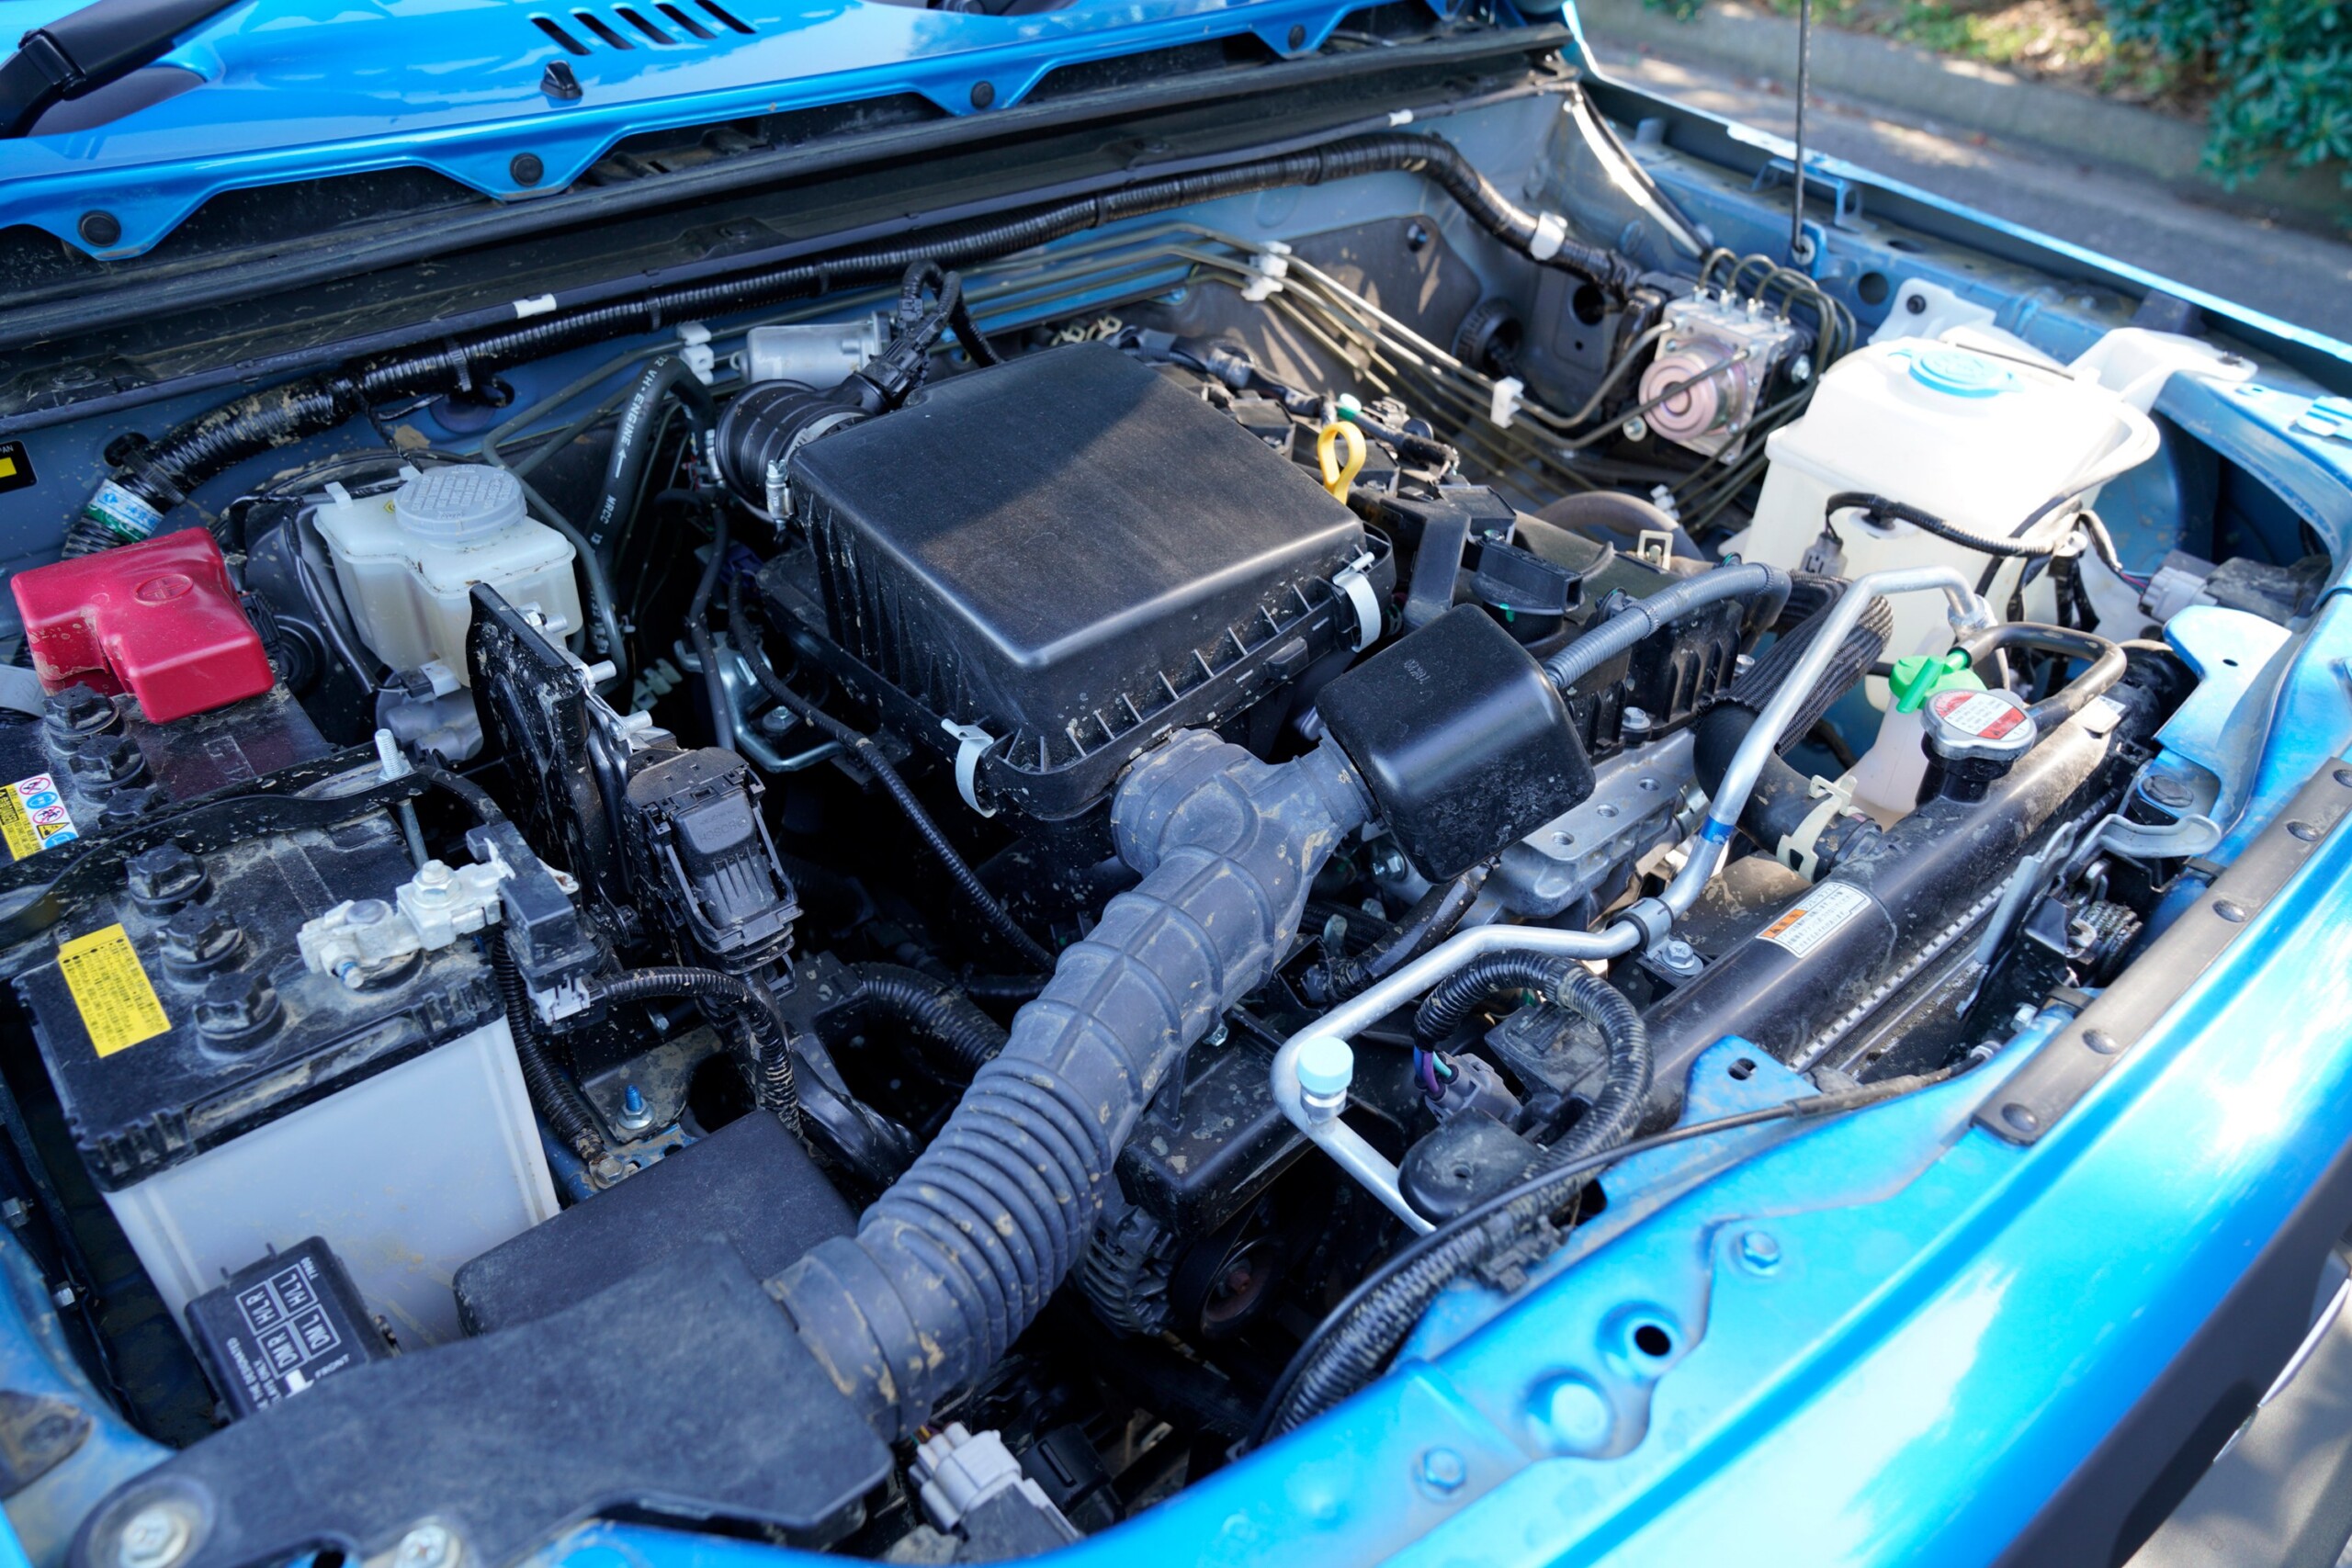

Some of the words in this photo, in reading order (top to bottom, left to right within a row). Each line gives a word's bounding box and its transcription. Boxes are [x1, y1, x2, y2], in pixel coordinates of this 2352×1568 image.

[279, 1273, 298, 1288] L
[246, 1291, 266, 1304] R
[284, 1282, 308, 1307] H/L
[252, 1300, 276, 1325] H/L
[300, 1314, 320, 1329] L
[267, 1332, 288, 1347] R
